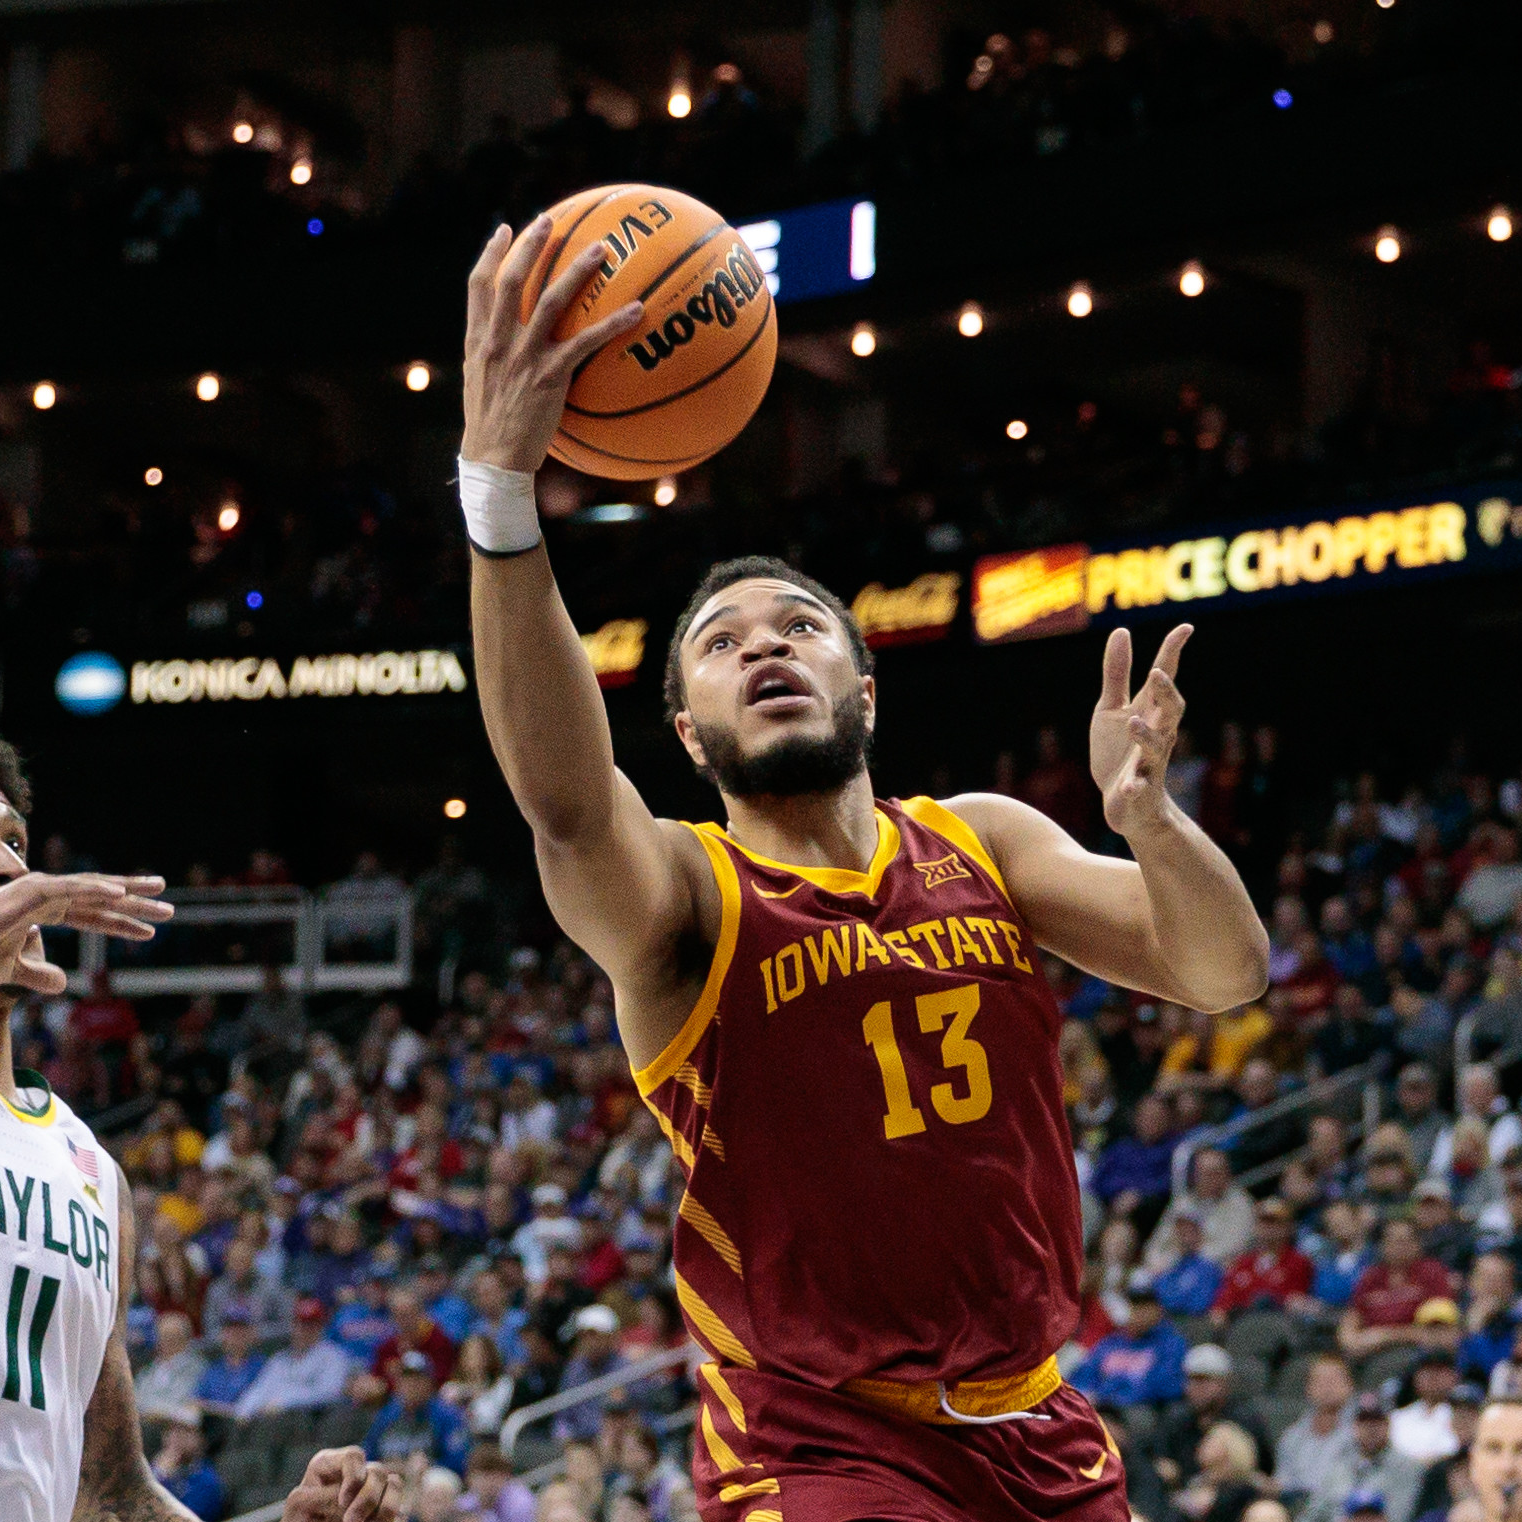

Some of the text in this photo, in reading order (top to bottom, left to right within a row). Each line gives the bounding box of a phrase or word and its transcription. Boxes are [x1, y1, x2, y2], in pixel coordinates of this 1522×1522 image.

[624, 242, 766, 371] Wilson
[1087, 536, 1227, 613] PRICE
[1226, 501, 1467, 594] CHOPPER
[130, 649, 468, 704] KONICA MINOLTA
[759, 916, 1035, 1015] IOWA STATE
[863, 982, 993, 1140] 13
[2, 1265, 62, 1411] 11
